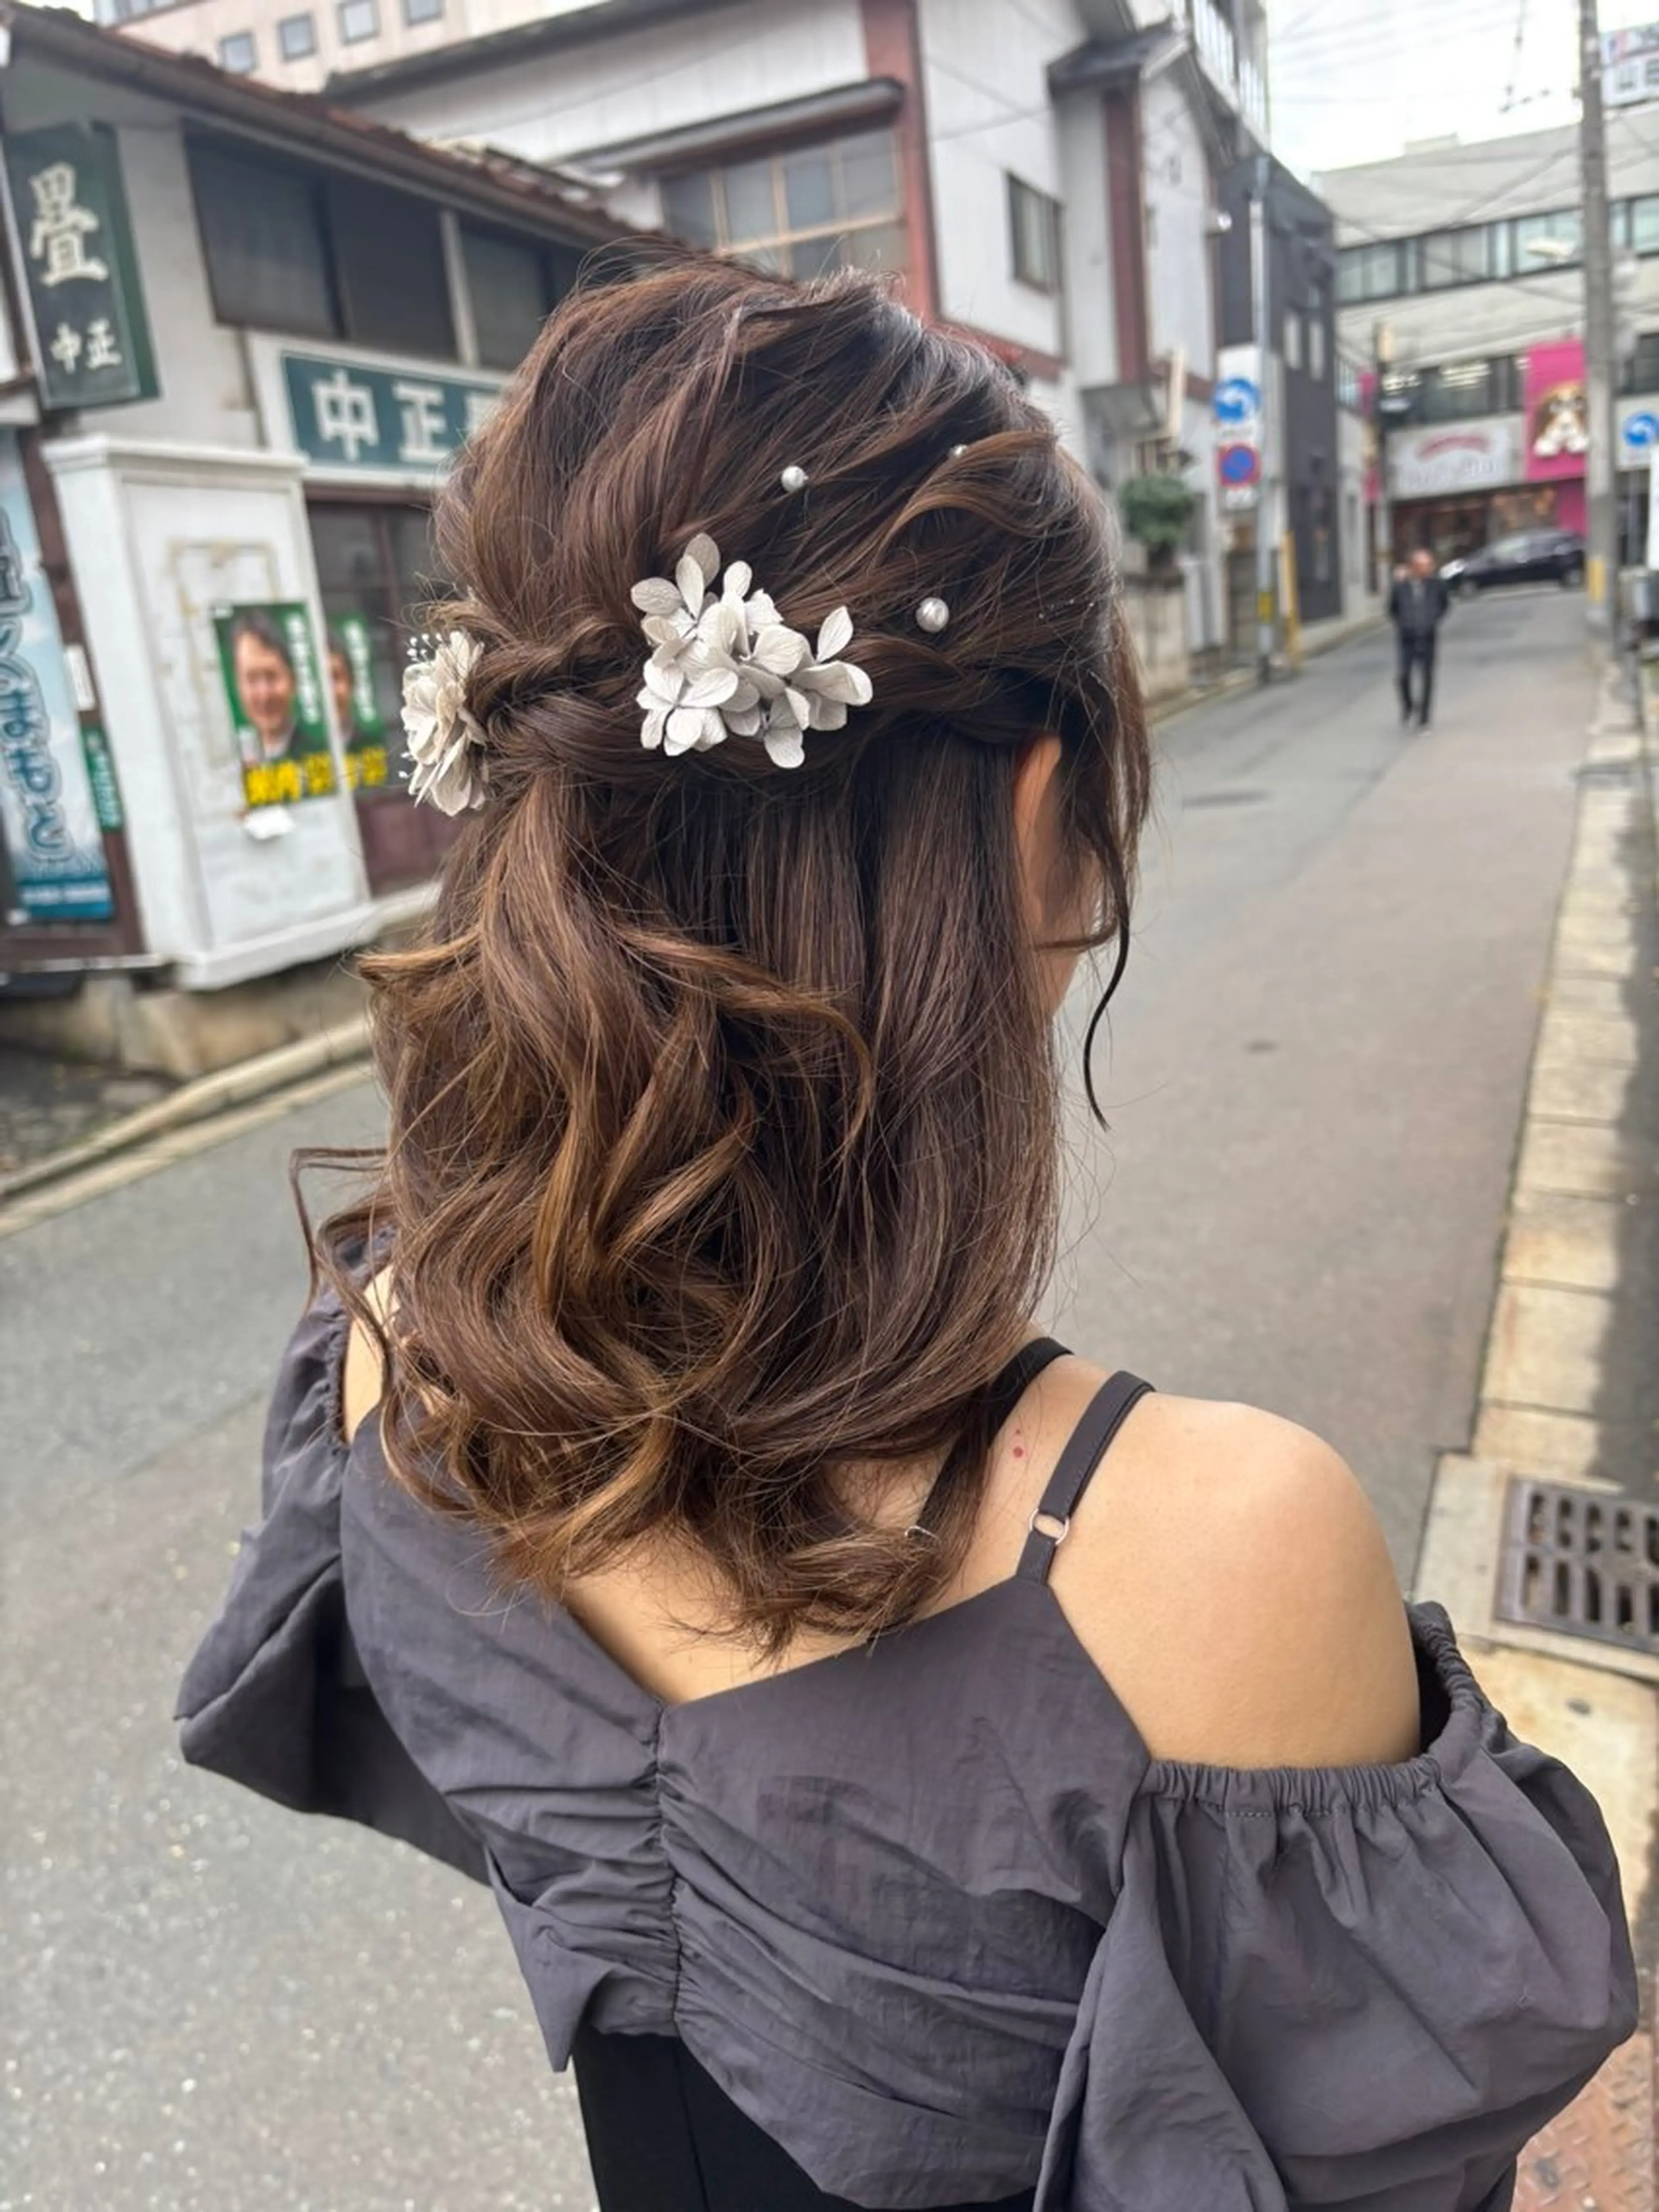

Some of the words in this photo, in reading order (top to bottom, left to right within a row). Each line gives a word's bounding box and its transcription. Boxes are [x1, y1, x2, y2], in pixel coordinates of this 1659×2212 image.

[29, 162, 109, 287] 畳
[50, 317, 123, 374] 中正
[311, 369, 500, 462] 中正
